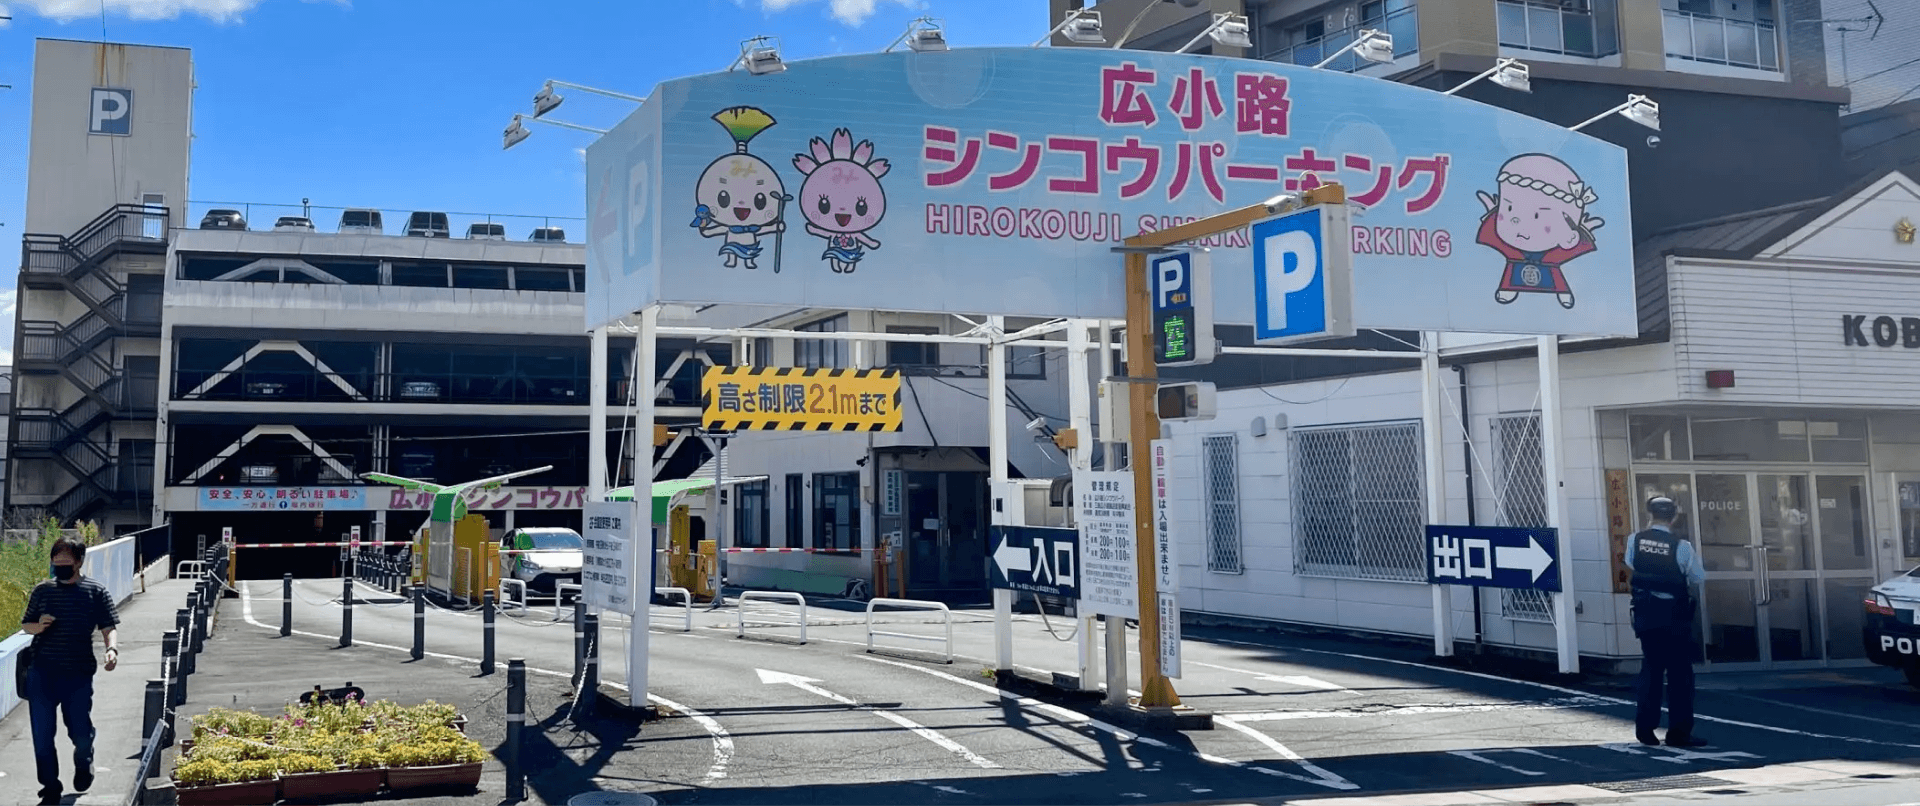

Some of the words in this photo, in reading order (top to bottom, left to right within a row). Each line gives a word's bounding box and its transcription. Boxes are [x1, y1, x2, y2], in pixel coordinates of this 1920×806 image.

[92, 90, 128, 131] P
[1100, 63, 1290, 136] 広小路
[925, 127, 1449, 213] シンコウパーキング
[926, 203, 1120, 242] HIROKOUJI
[1351, 225, 1452, 258] RKING
[1158, 259, 1183, 308] P
[1264, 230, 1317, 331] P
[1164, 316, 1186, 358] 空
[718, 382, 887, 416] 高さ制限2.1mまで
[1156, 445, 1170, 586] 自動二輪車は入場出来ません
[1700, 501, 1742, 511] POLICE
[1032, 537, 1075, 588] 入口
[1433, 534, 1492, 580] 出口
[1639, 545, 1670, 556] POLICE
